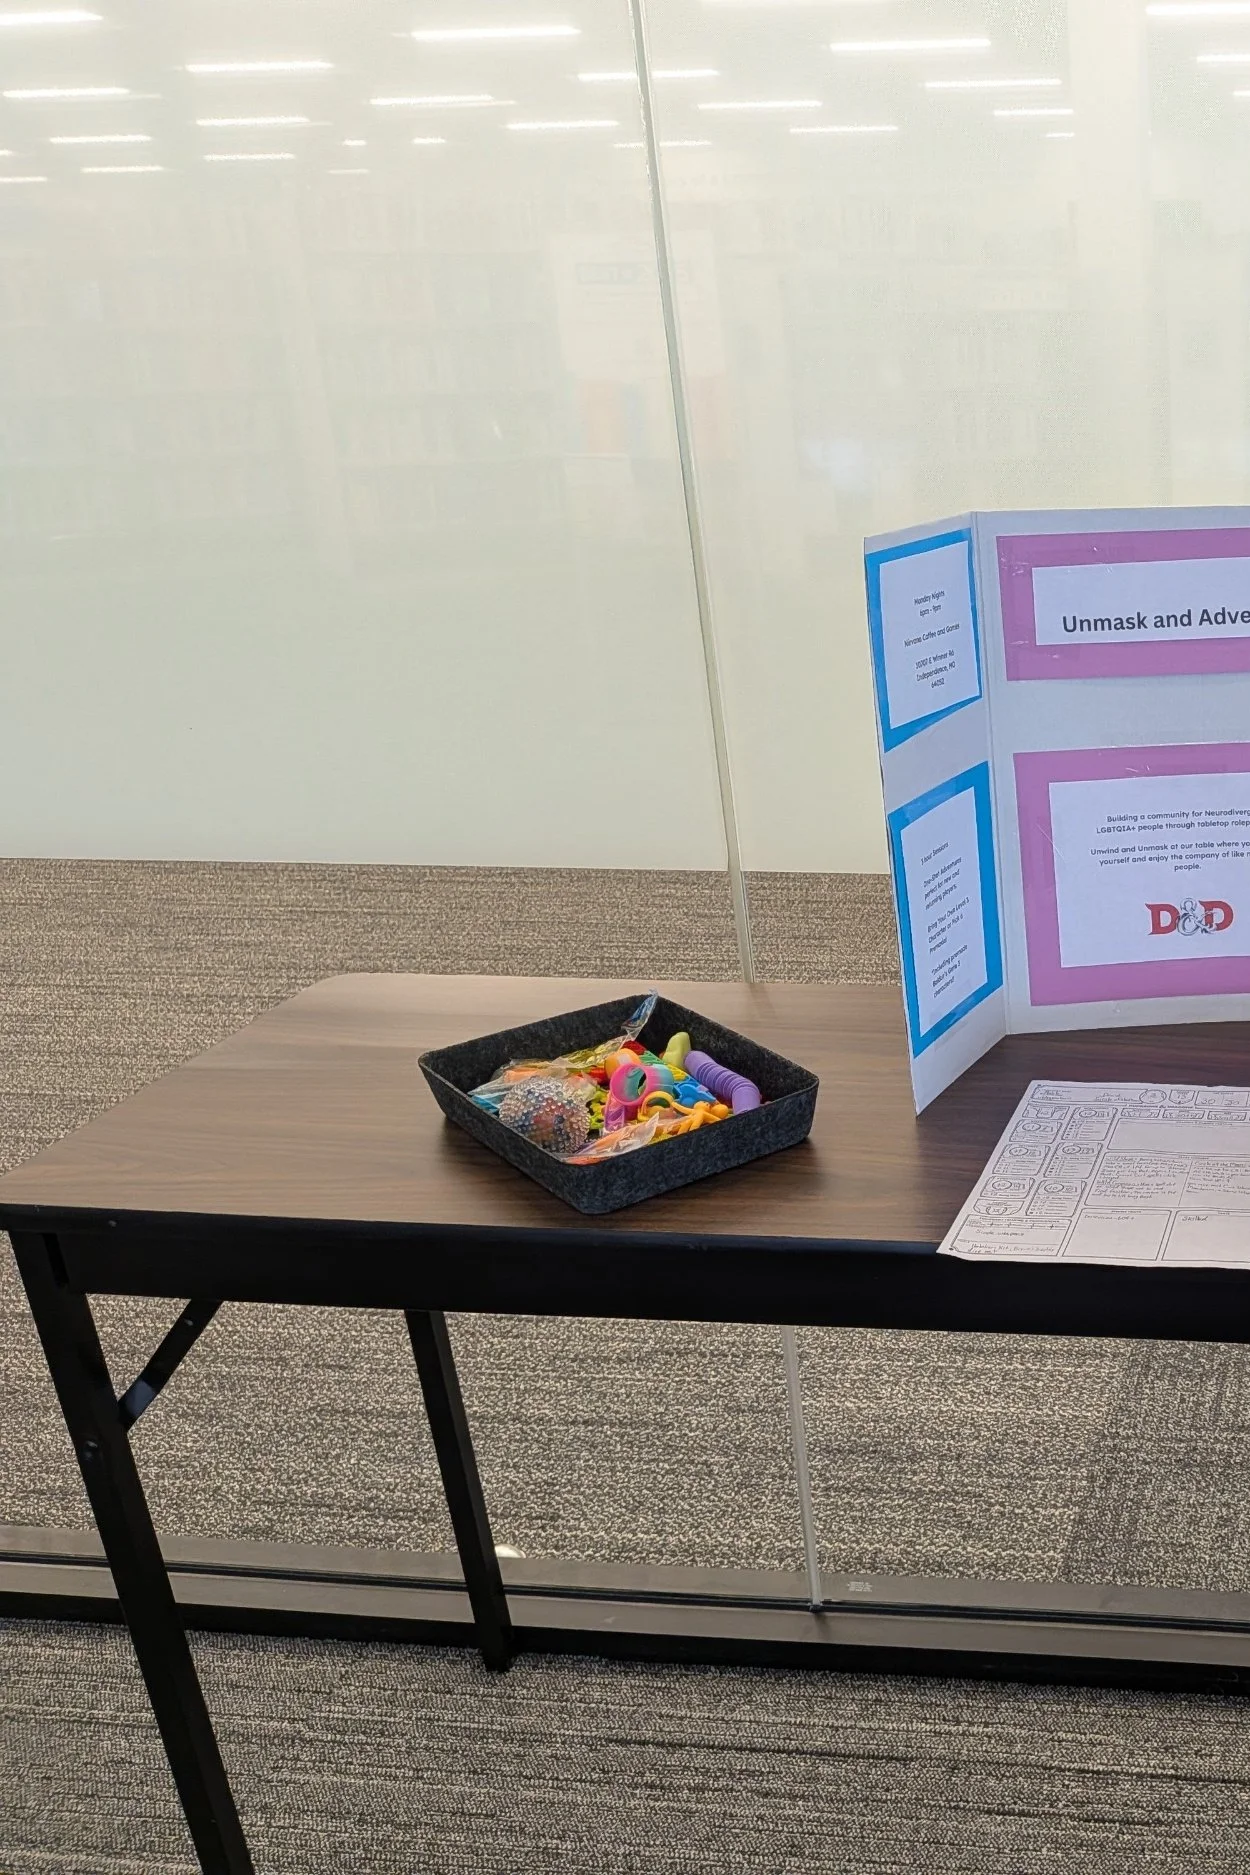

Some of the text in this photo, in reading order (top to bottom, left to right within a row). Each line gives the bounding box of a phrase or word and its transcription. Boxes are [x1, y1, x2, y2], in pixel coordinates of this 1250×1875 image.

[914, 590, 945, 605] Monday Nights
[1063, 611, 1148, 633] Unmask
[1153, 608, 1192, 628] and
[922, 631, 936, 641] Coffee
[937, 627, 945, 636] and
[1107, 814, 1138, 823] Building
[1147, 810, 1190, 821] community
[1138, 822, 1163, 832] people
[1166, 820, 1195, 830] through
[1198, 819, 1229, 828] tabletop
[1091, 846, 1119, 856] Unwind
[1122, 845, 1136, 853] and
[1138, 843, 1168, 852] Unmask
[1195, 841, 1215, 849] table
[1217, 840, 1239, 848] where
[1099, 856, 1130, 866] yourself
[1132, 855, 1146, 863] and
[1149, 854, 1169, 863] enjoy
[1171, 852, 1183, 860] the
[1185, 852, 1220, 862] company
[1231, 849, 1245, 857] like
[1174, 862, 1201, 872] people.
[1145, 897, 1234, 936] D&D
